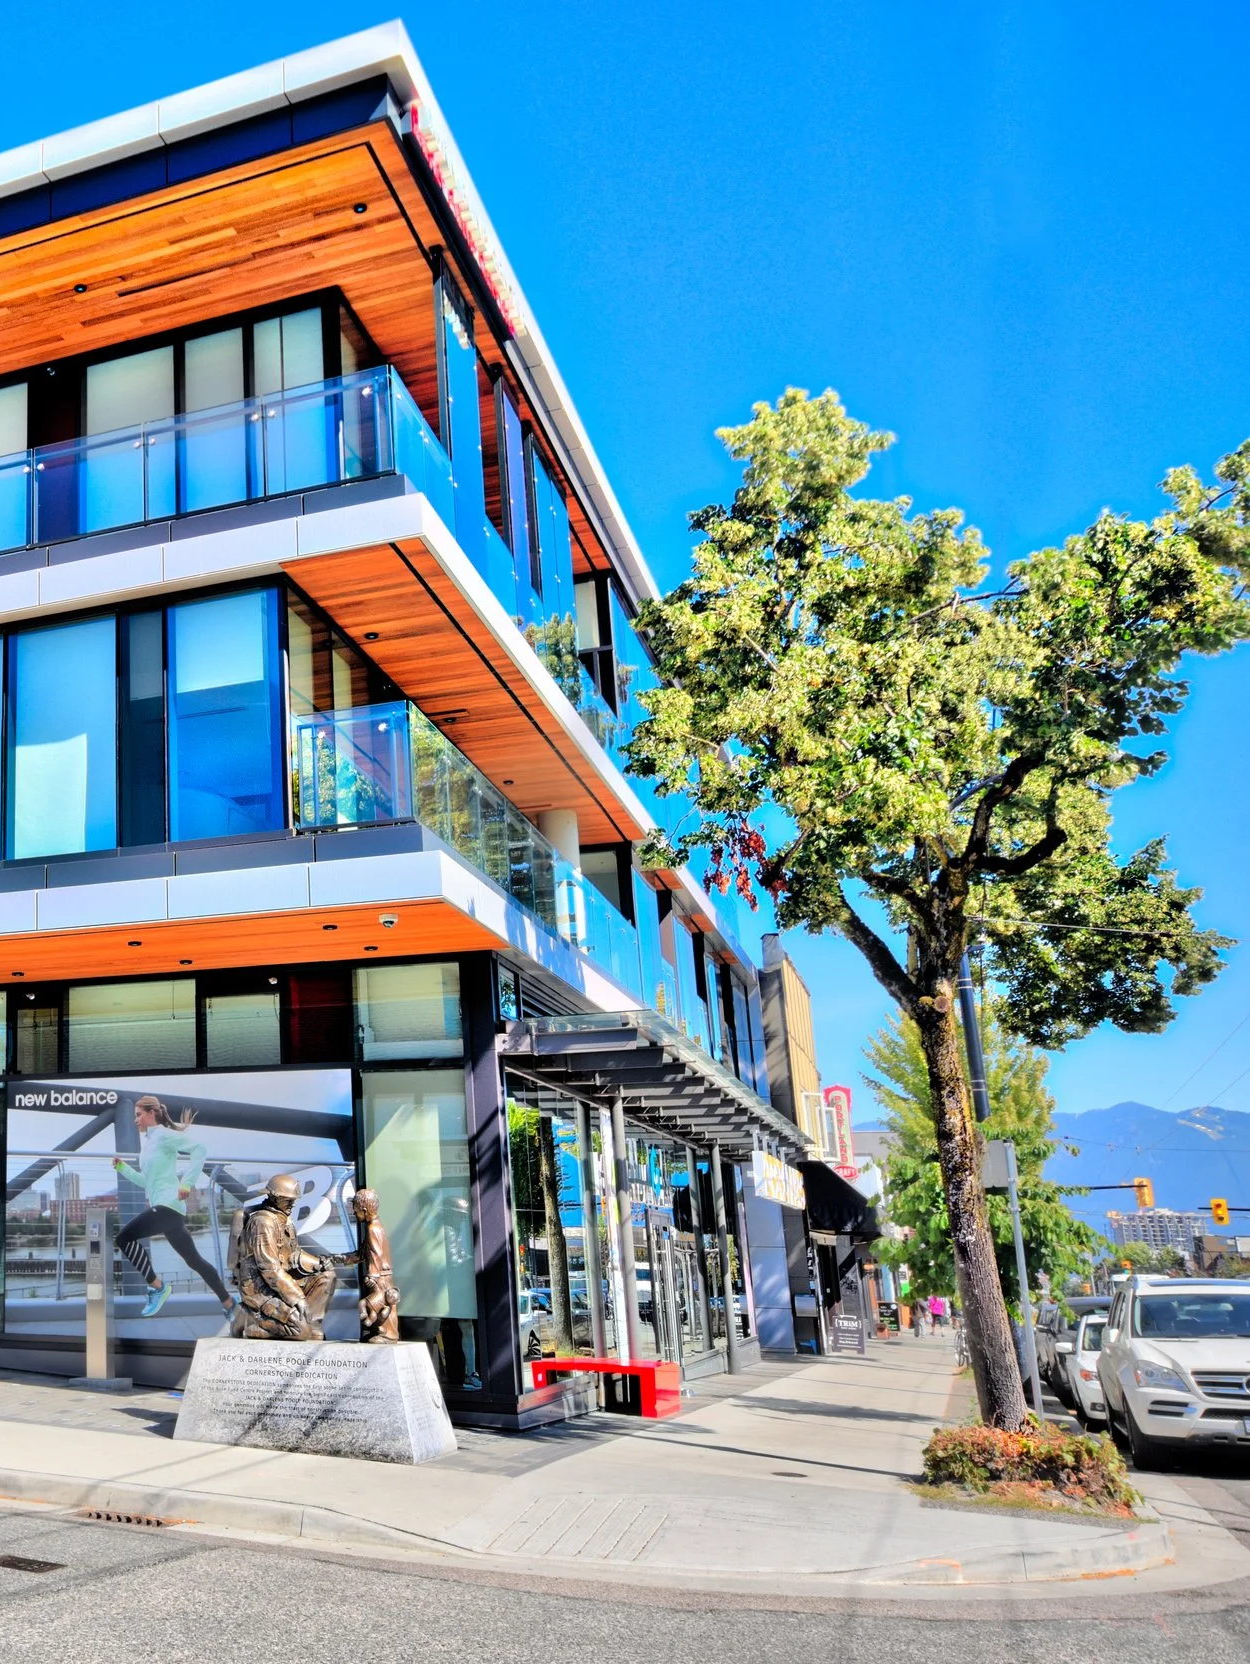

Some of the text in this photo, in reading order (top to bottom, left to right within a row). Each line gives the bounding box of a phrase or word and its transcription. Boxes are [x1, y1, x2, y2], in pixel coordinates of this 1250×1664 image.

[15, 1089, 118, 1107] new balance
[833, 1096, 849, 1163] PORTLAND
[248, 1356, 282, 1364] DARLENE
[286, 1358, 311, 1366] POOLE
[314, 1359, 368, 1368] FOUNDATION
[246, 1369, 338, 1380] CORNERSTONE DEDICATION
